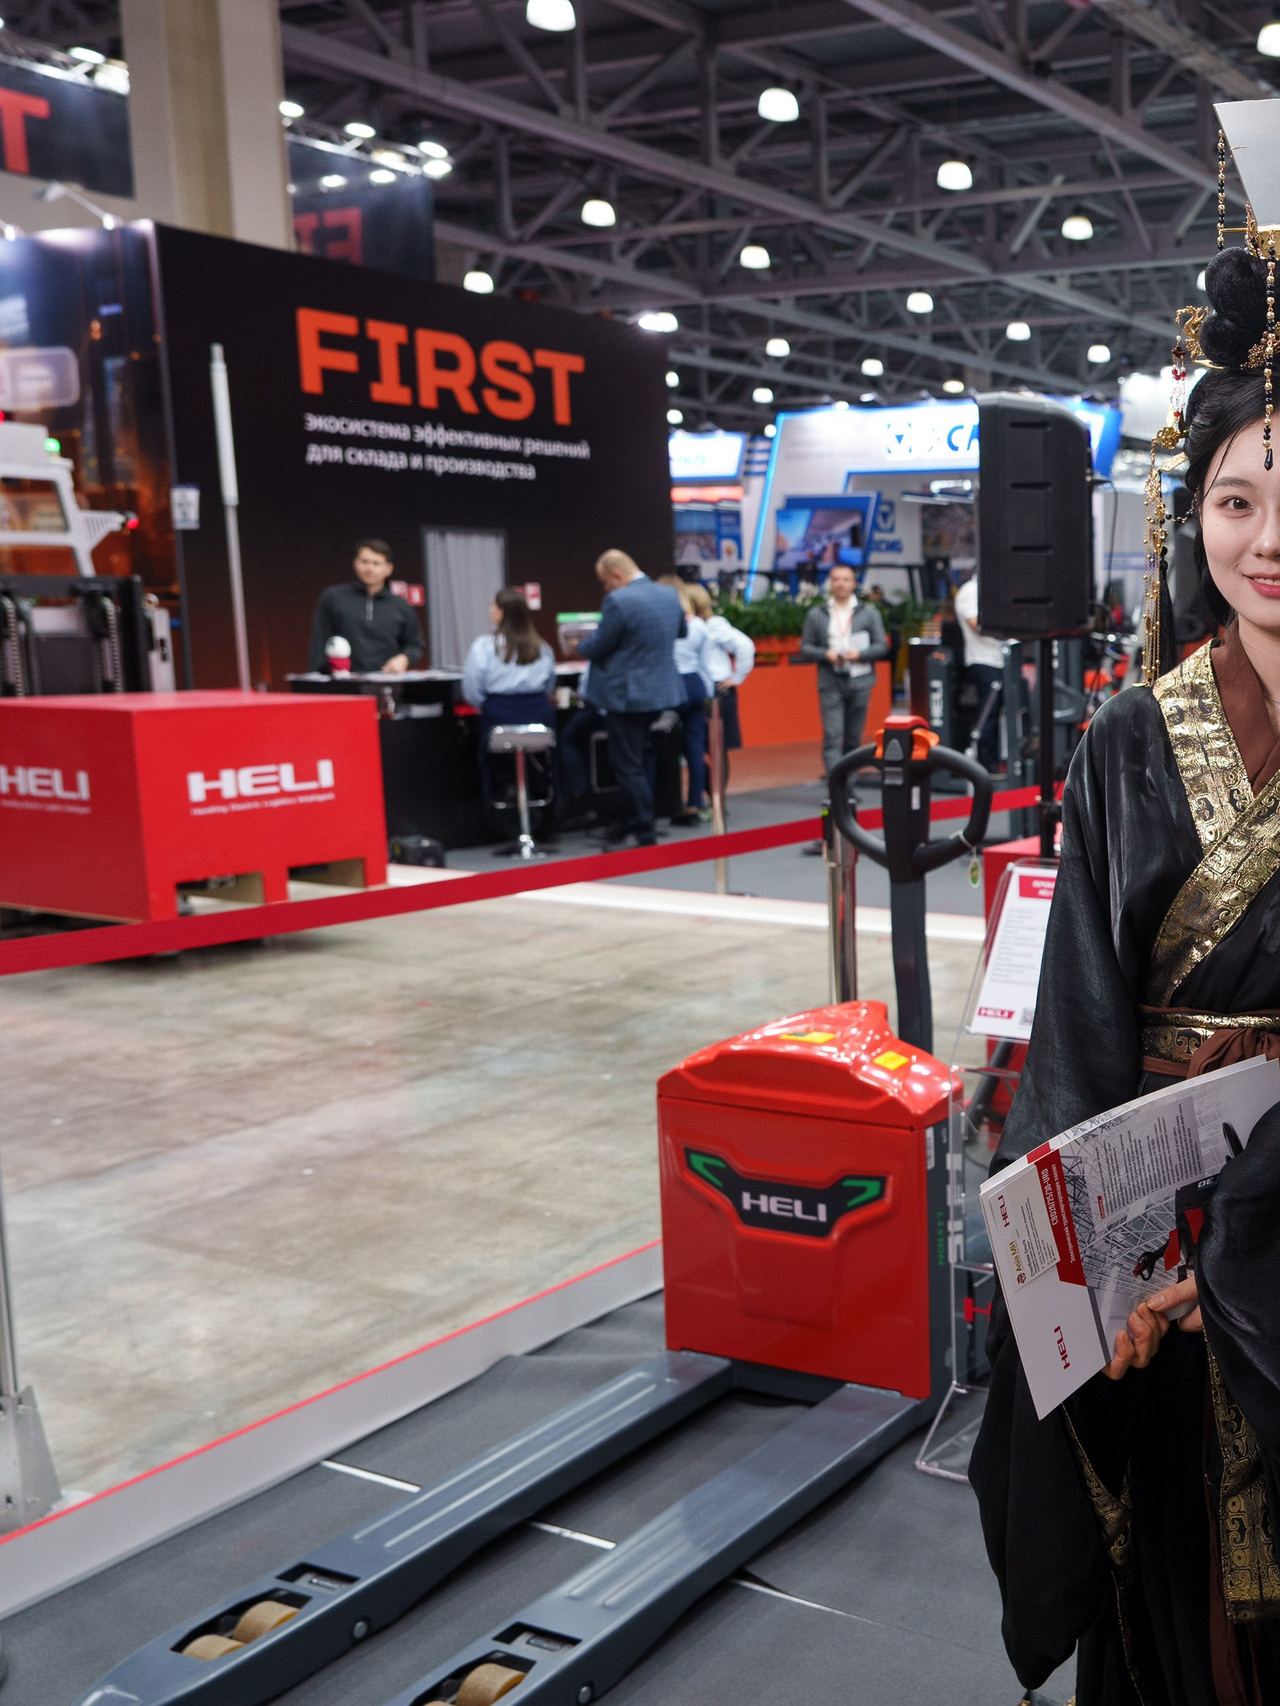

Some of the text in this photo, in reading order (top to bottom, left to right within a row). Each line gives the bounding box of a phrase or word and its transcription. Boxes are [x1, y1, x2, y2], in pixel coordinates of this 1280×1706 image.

[295, 306, 586, 426] FIRST
[303, 412, 591, 459] экосистема эффективных решений
[306, 443, 537, 481] для склада и производства
[0, 765, 90, 801] HELI
[187, 759, 335, 803] HELI
[742, 1191, 828, 1222] HELI
[997, 1195, 1010, 1228] HELI
[1041, 1168, 1059, 1226] CBD20/25/30-URD
[1008, 1240, 1023, 1272] Asia MH
[1053, 1325, 1071, 1370] HELI
